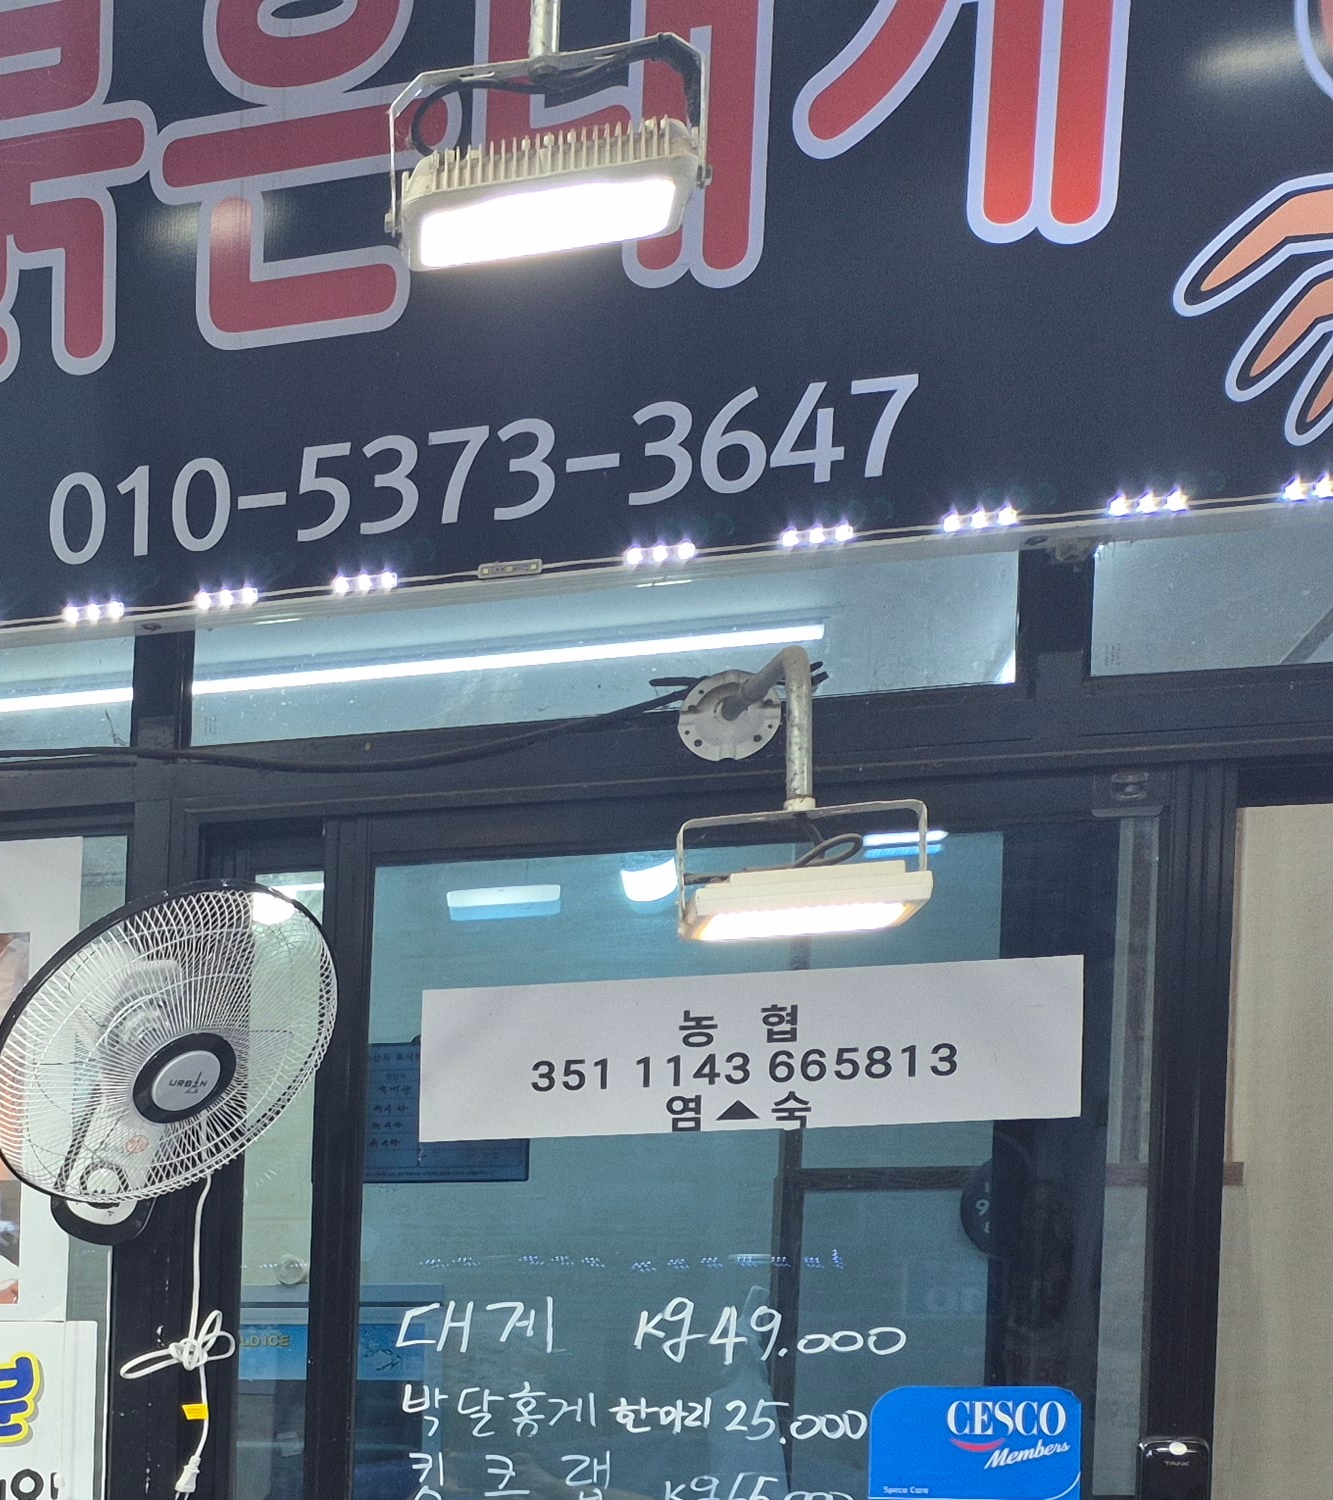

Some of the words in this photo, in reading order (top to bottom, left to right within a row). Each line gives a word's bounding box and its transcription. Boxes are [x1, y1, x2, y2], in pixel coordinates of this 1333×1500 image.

[48, 373, 921, 565] 010-5373-3647
[531, 1058, 610, 1092] 351
[636, 1052, 751, 1088] 1143
[768, 1042, 958, 1081] 665813
[947, 1400, 1067, 1436] CESCO
[983, 1439, 1071, 1470] Members
